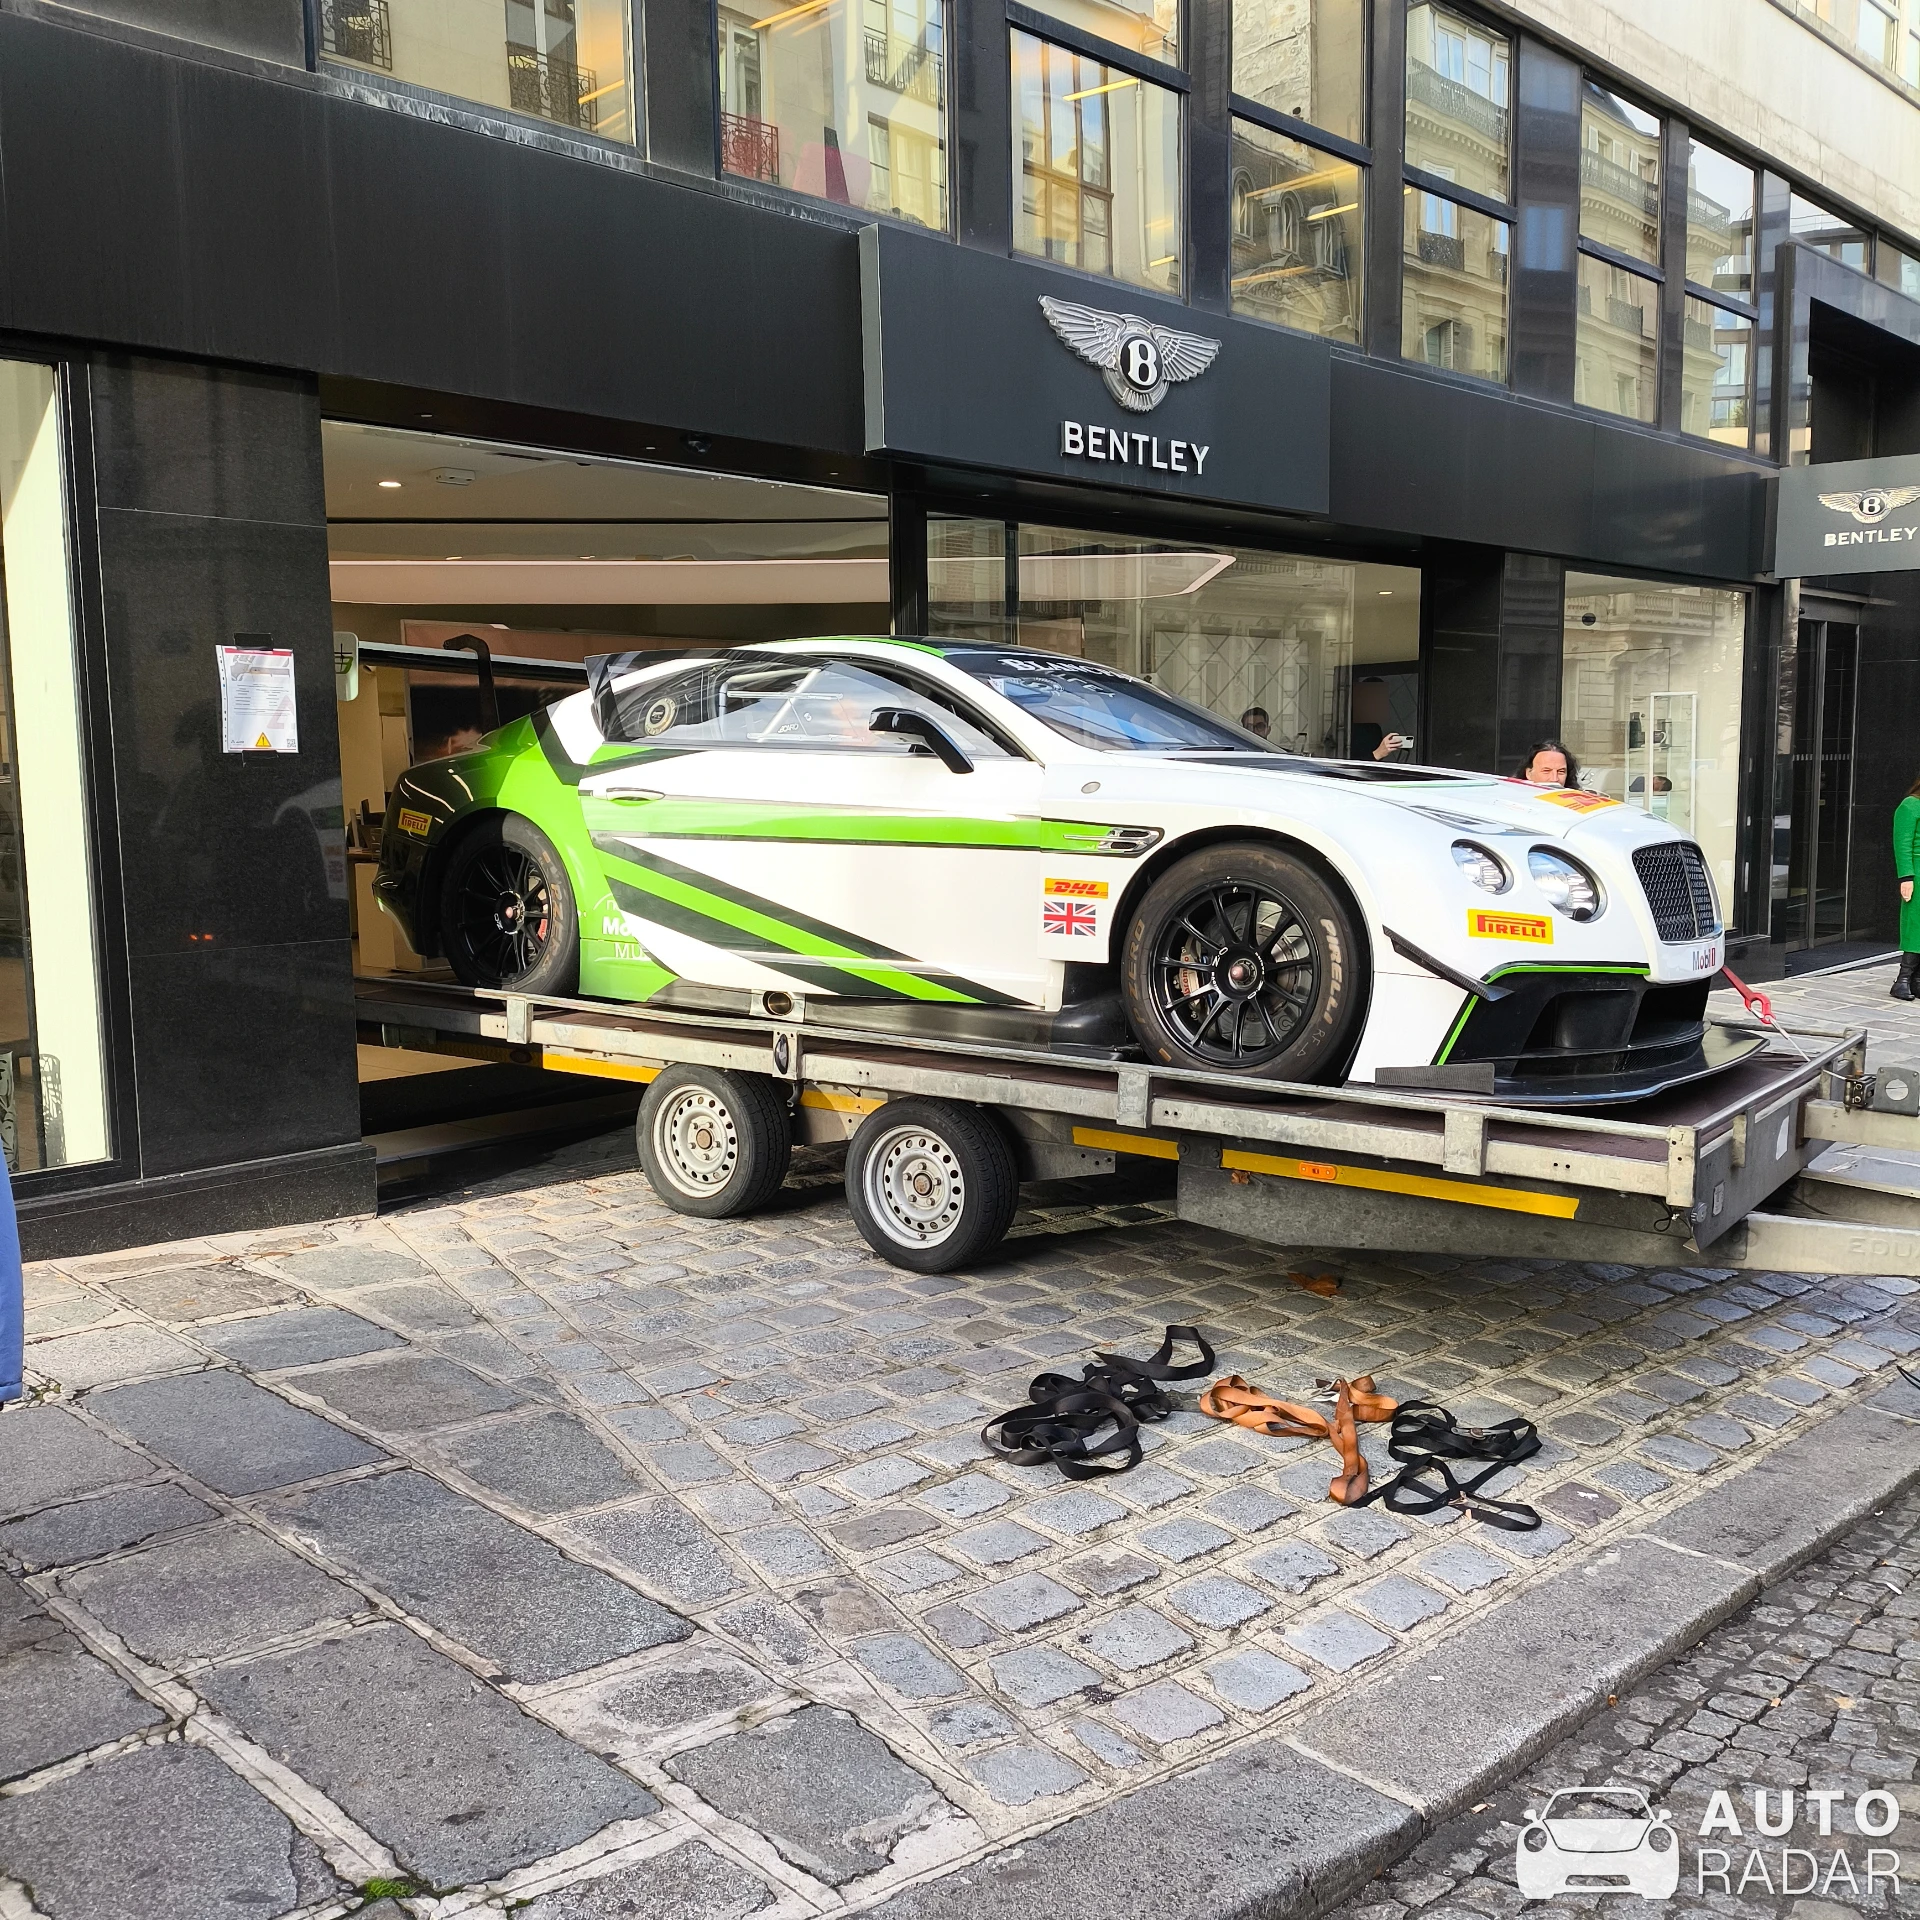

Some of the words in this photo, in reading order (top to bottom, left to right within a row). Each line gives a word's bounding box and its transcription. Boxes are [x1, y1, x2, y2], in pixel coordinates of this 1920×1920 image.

[1128, 338, 1159, 387] B
[1062, 420, 1210, 475] BENTLEY
[1824, 526, 1918, 547] BENTLEY
[402, 812, 429, 832] PIRELLI
[1053, 881, 1100, 896] DHL
[1476, 914, 1547, 939] PIRELLI
[1128, 918, 1146, 1001] ZERO
[1320, 918, 1343, 1025] PIRELLI
[1182, 956, 1191, 996] bremo
[1849, 1235, 1920, 1259] EDU
